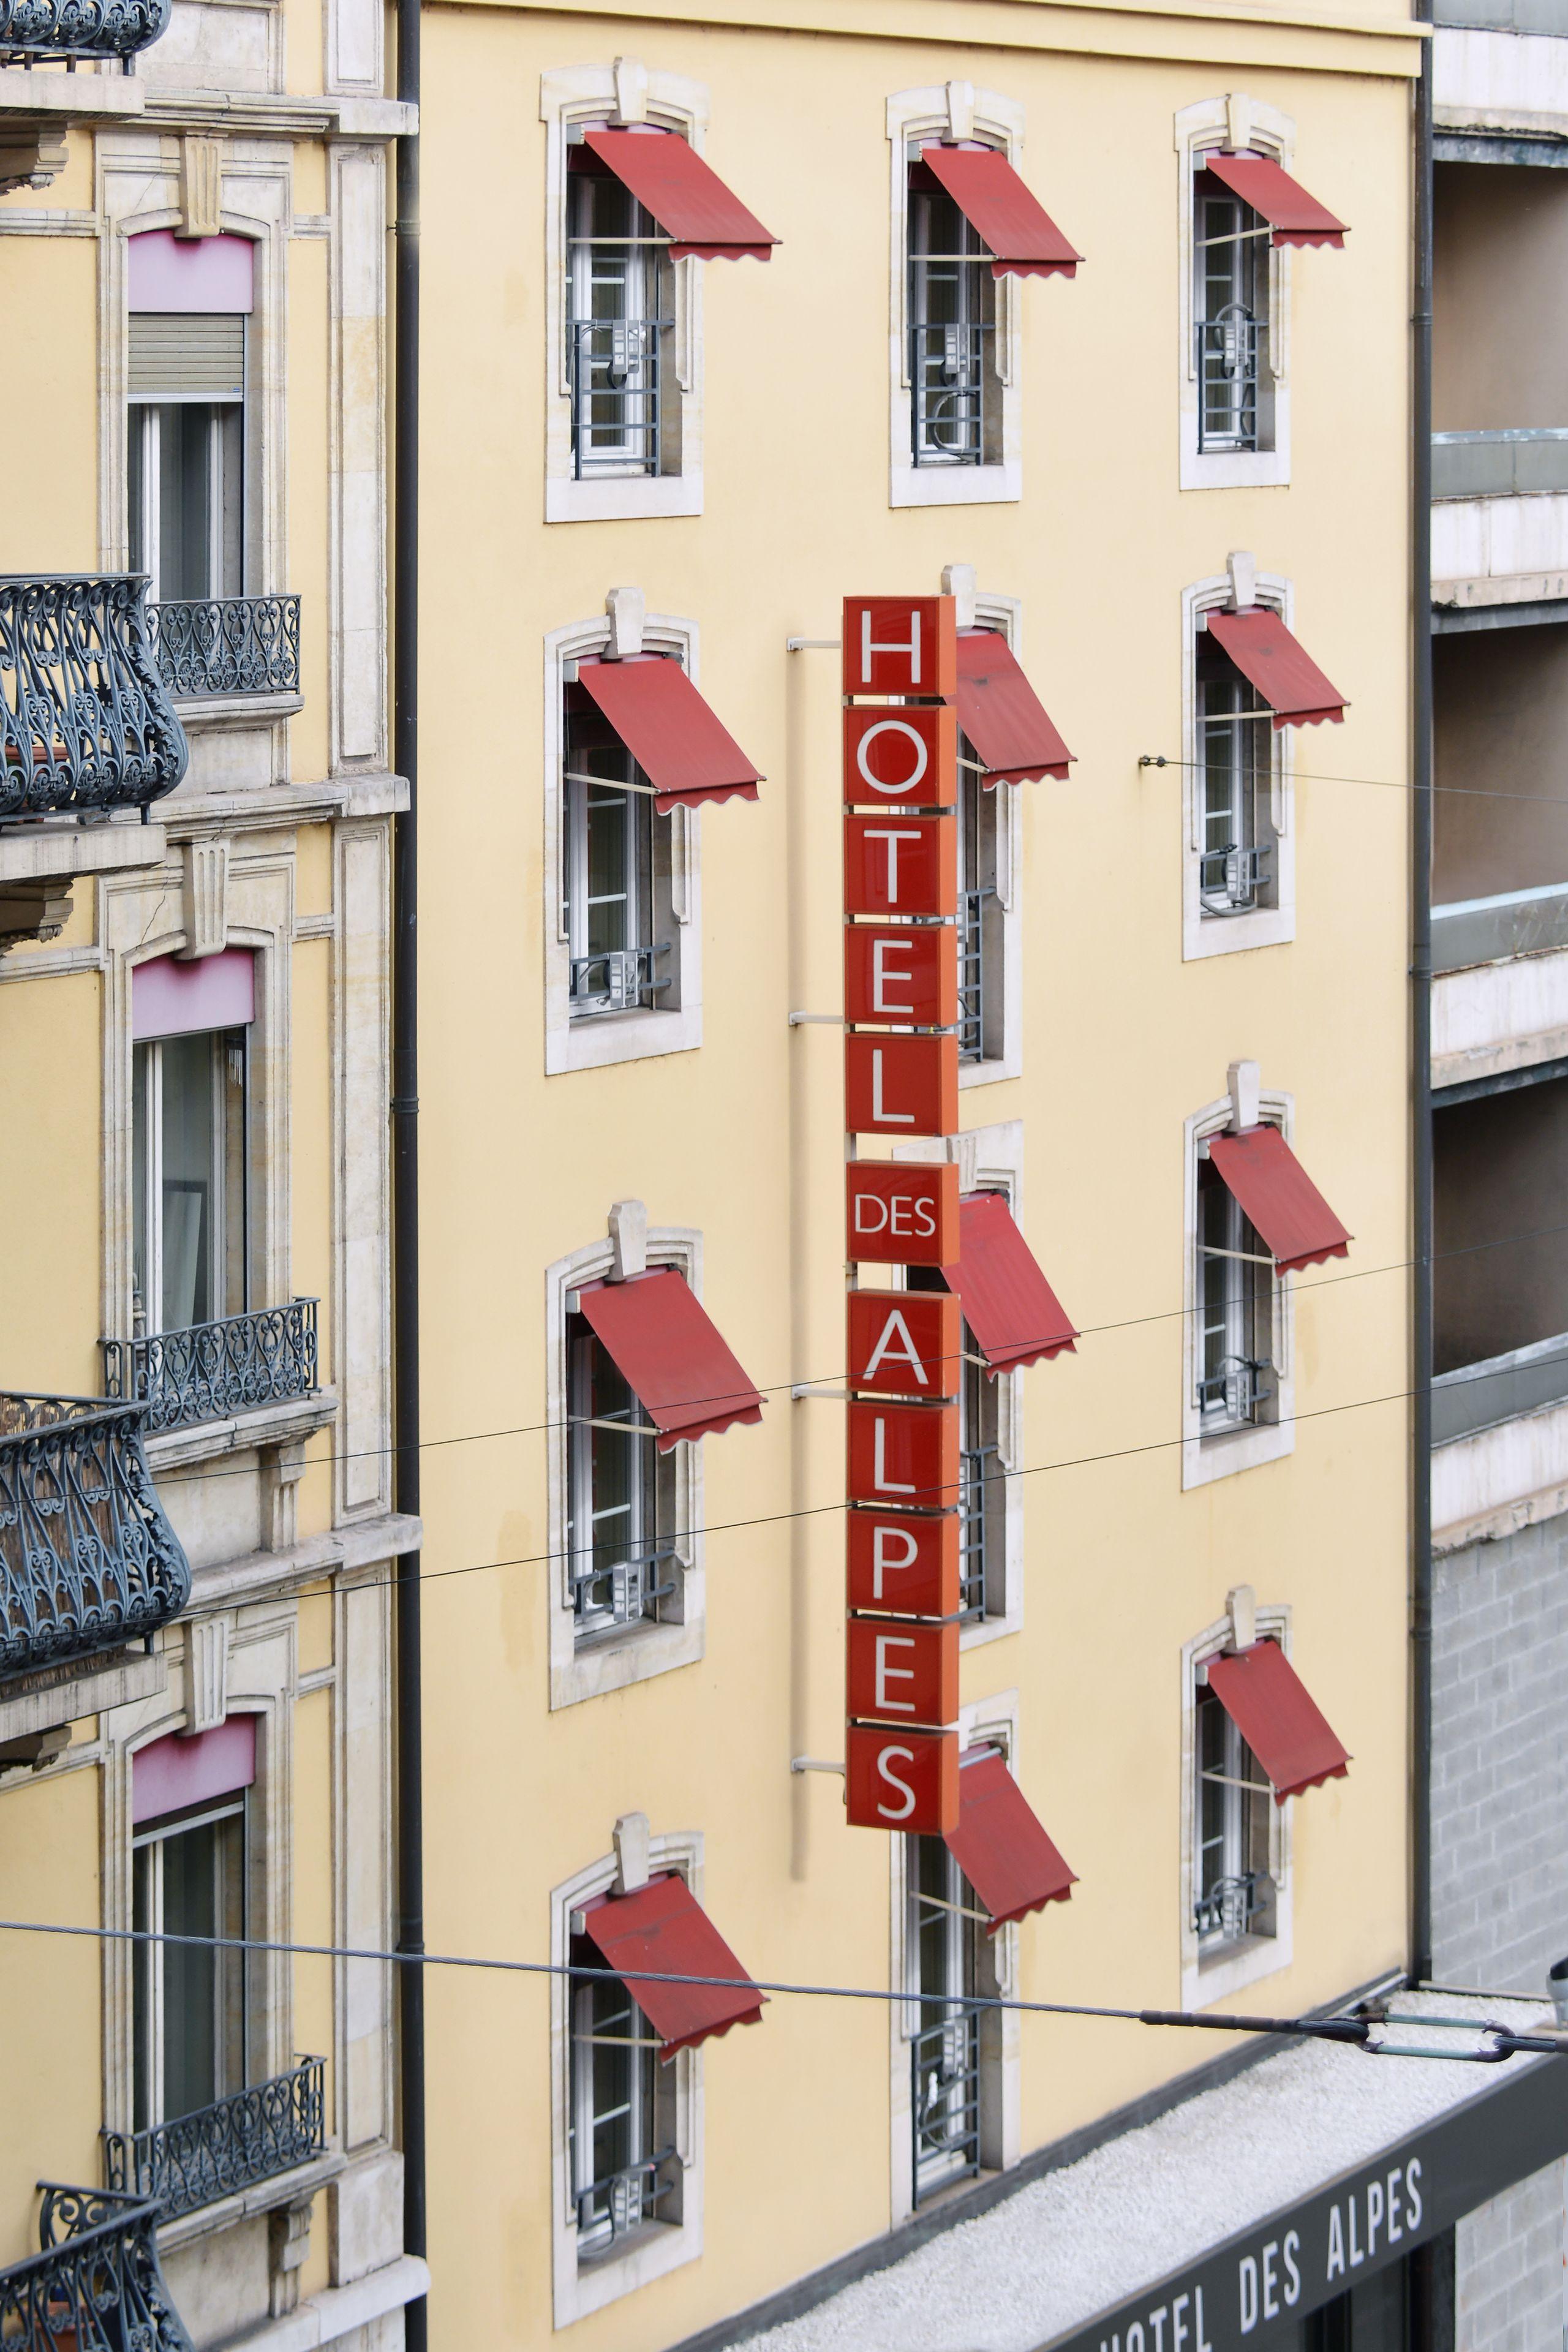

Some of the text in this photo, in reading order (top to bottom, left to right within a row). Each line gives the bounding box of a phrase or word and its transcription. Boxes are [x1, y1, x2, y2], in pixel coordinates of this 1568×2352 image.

[855, 610, 936, 1820] HOTEL DES ALPES
[1100, 2157, 1422, 2352] TEL DES ALPES
